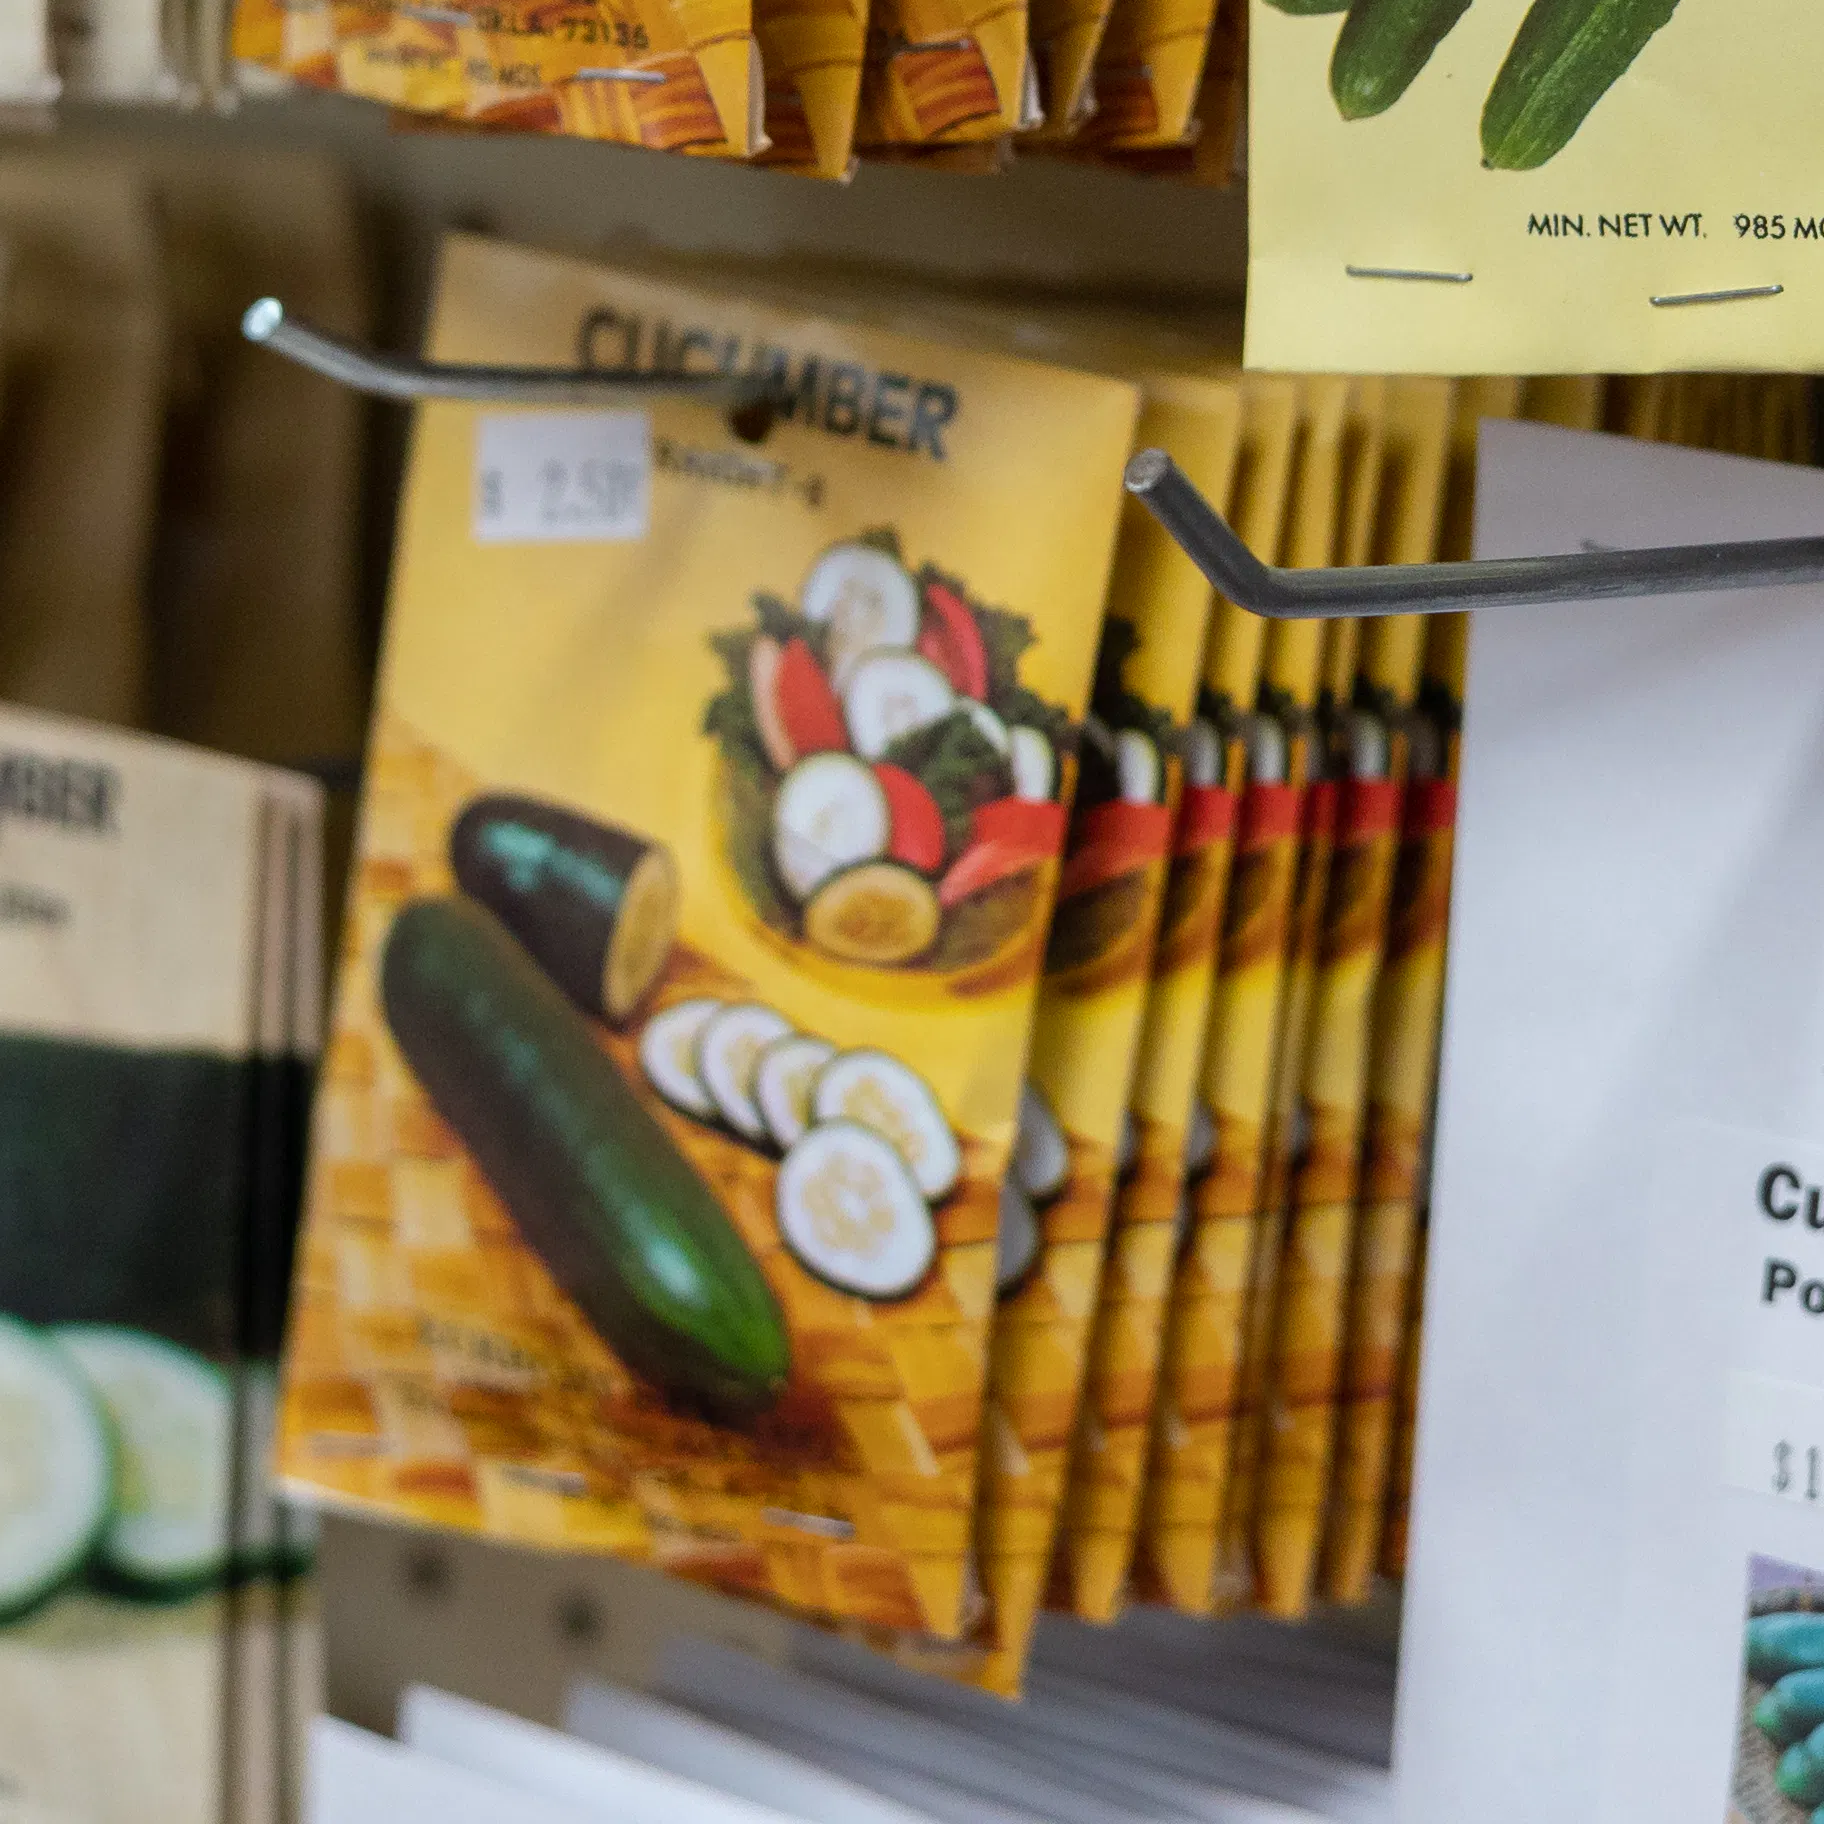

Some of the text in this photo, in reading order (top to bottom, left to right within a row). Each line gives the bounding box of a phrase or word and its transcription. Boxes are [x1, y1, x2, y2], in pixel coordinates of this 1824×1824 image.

[1527, 212, 1591, 238] MIN.
[1598, 212, 1652, 239] NET
[1659, 212, 1708, 240] WT.
[1733, 212, 1787, 241] 985
